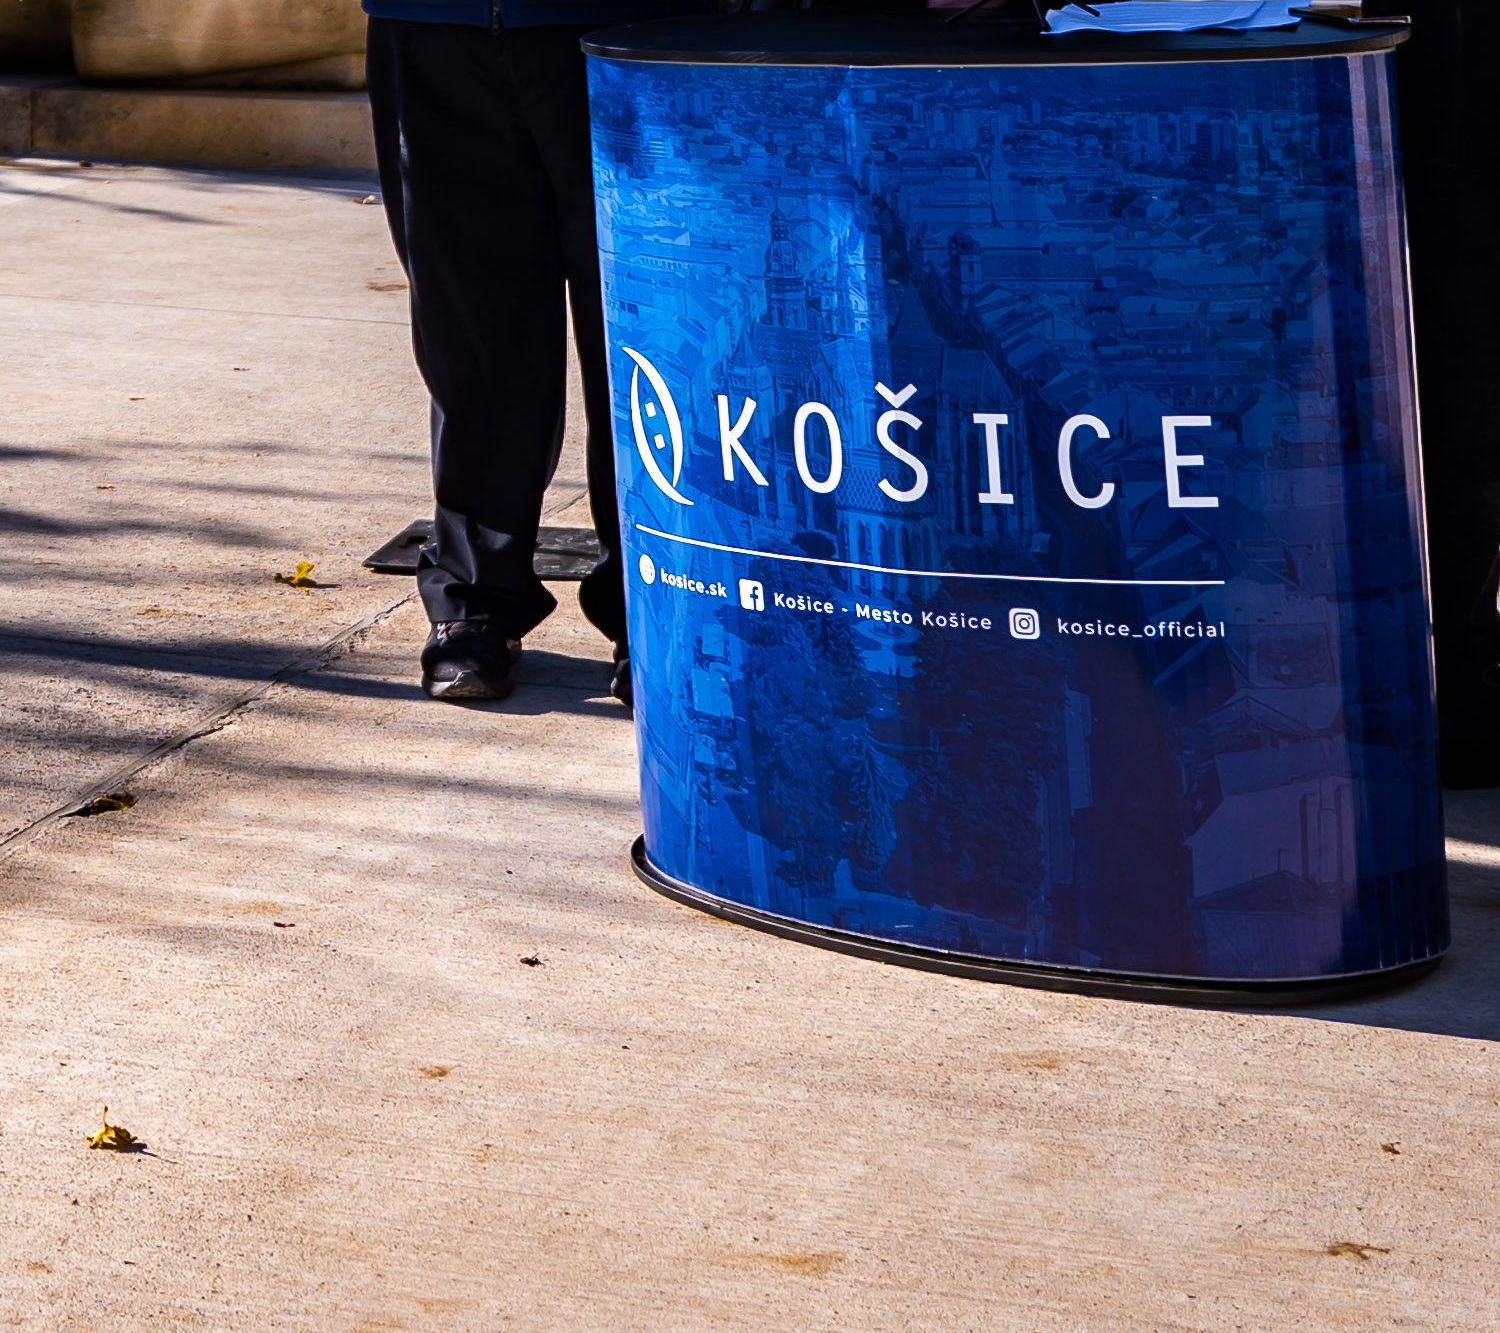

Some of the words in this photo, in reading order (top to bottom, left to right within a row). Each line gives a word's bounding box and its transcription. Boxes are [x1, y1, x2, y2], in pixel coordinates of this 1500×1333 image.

[716, 381, 1219, 509] KOŠICE
[660, 567, 728, 598] kosice.sk
[773, 592, 834, 614] Košice
[856, 603, 913, 625] Mesto
[922, 611, 993, 630] Košice
[1057, 618, 1226, 638] kosice_official
